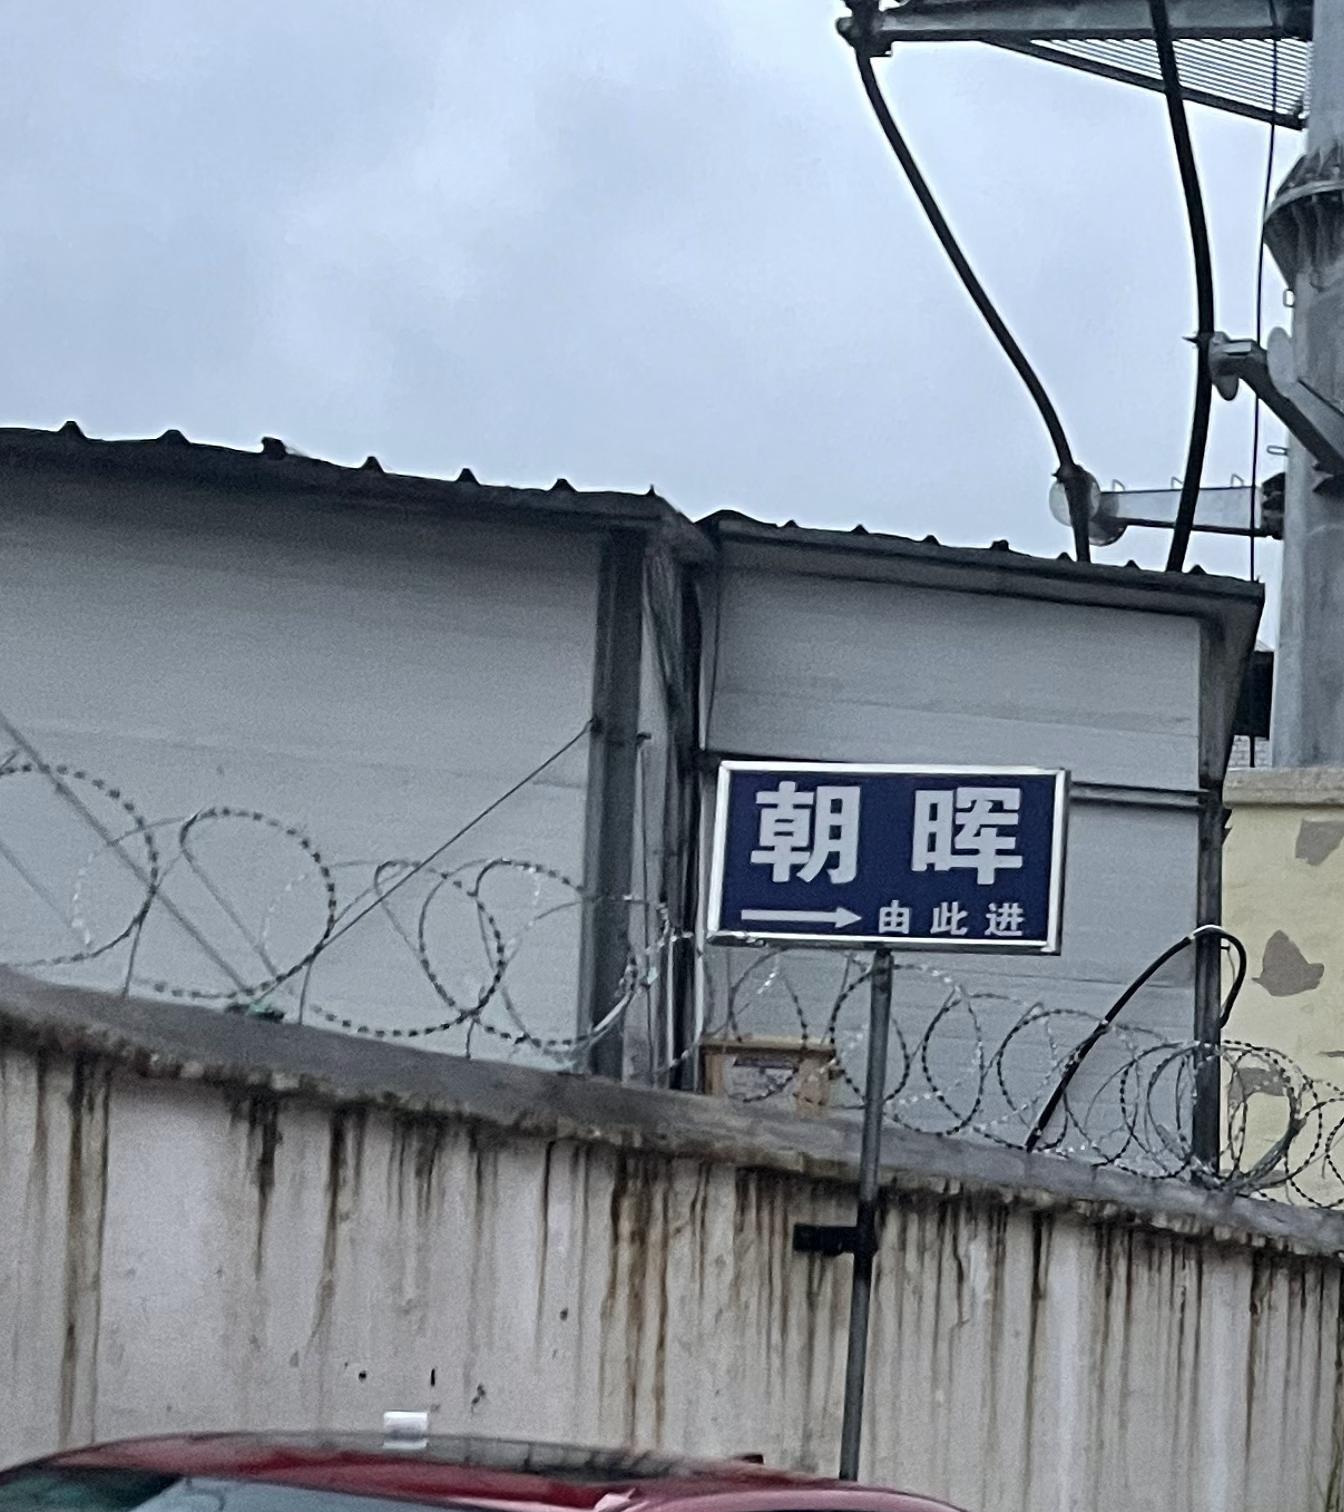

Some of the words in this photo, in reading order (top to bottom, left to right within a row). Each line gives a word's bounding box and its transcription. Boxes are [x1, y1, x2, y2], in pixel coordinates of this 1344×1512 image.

[750, 780, 1023, 885] 朝晖
[878, 900, 1025, 937] 由此进
